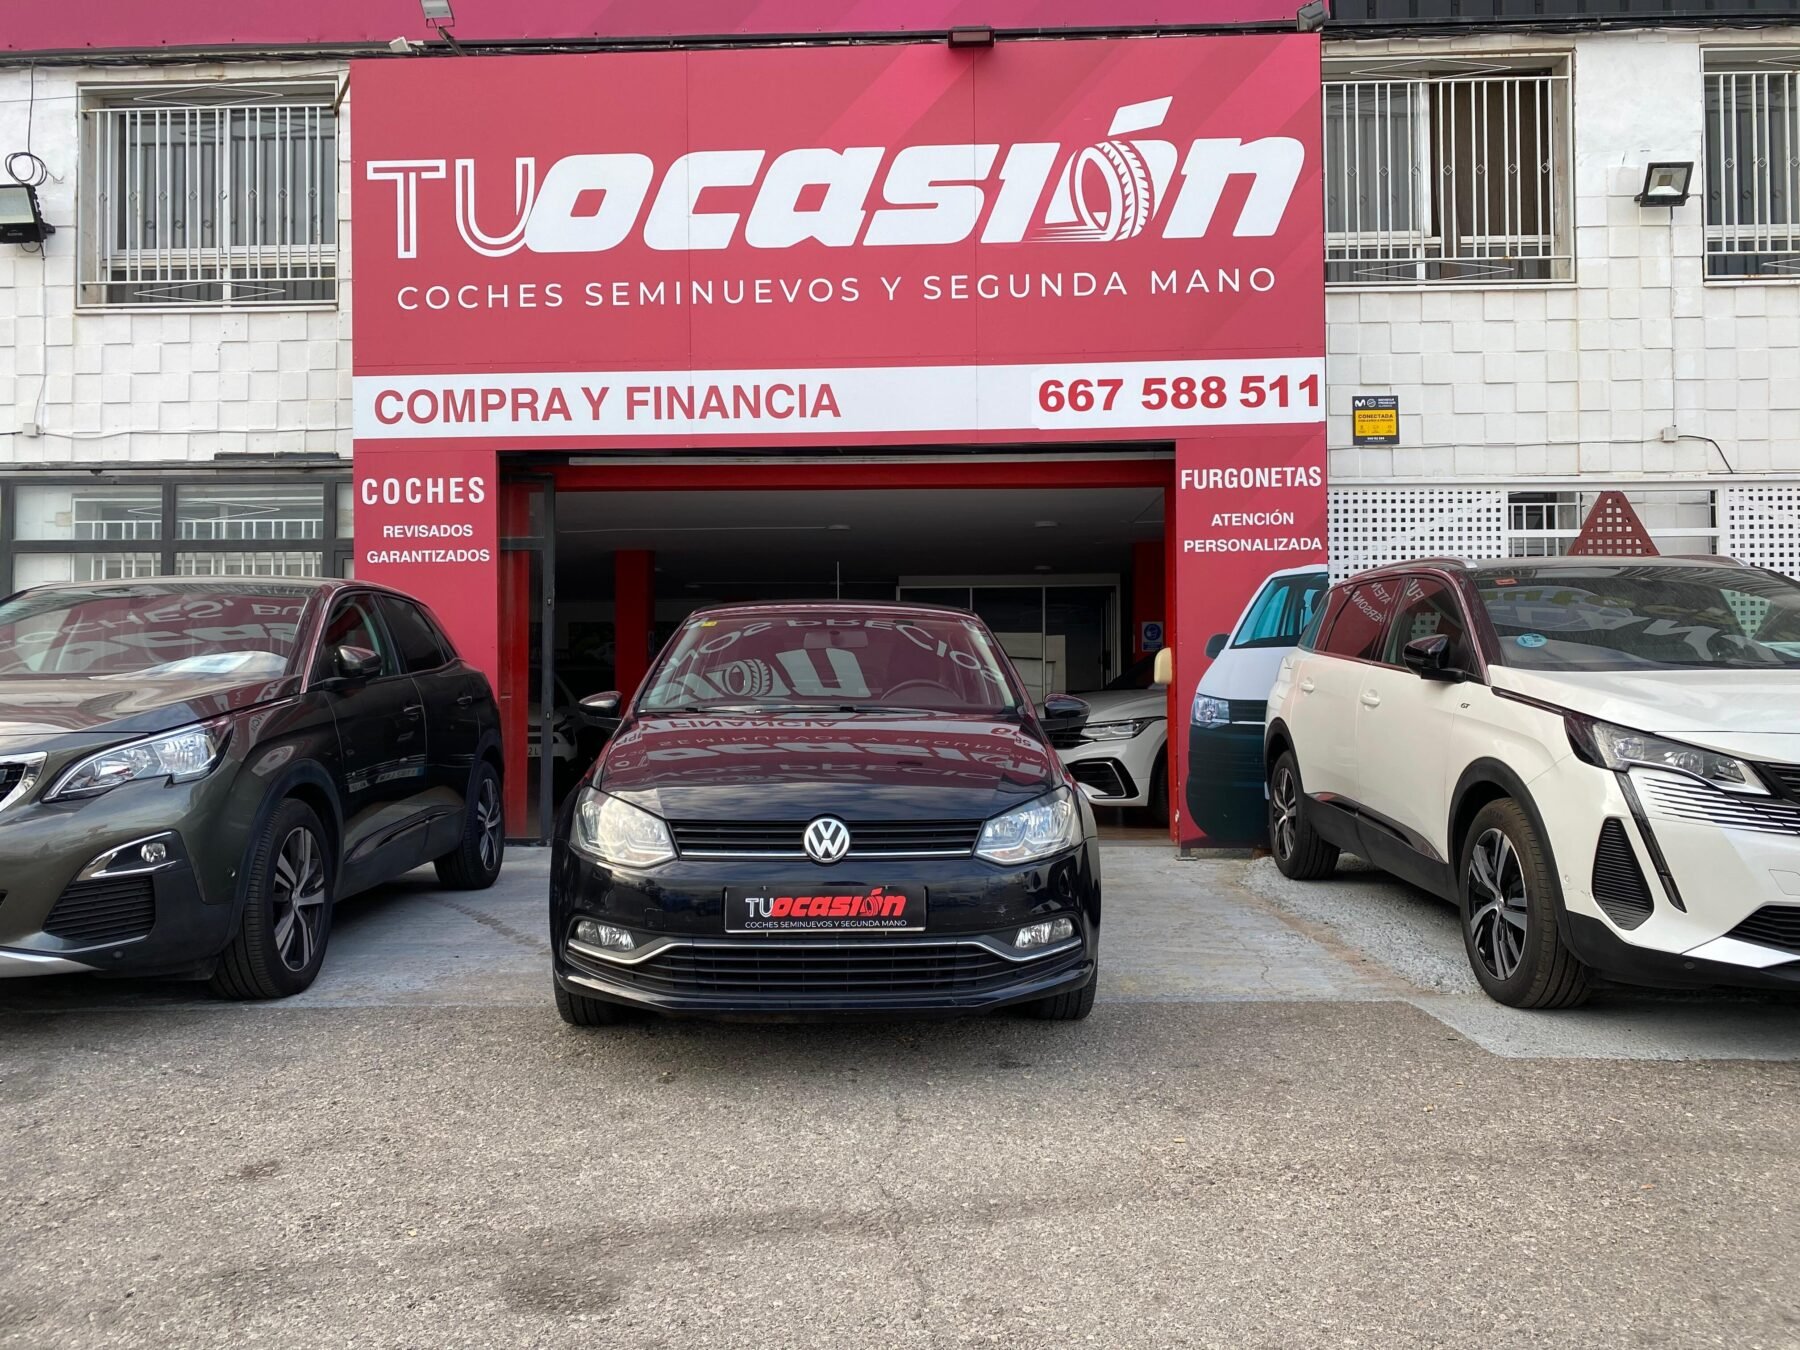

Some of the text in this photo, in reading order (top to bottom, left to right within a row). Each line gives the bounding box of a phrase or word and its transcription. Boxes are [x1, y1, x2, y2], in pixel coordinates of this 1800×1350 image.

[397, 267, 1275, 310] COCHES SEMINUEVOS Y SEGUNDA MANO
[374, 374, 1319, 424] COMPRA Y FINANCIA 667 588 511
[1181, 466, 1322, 490] FURGONETAS
[361, 476, 485, 505] COCHES
[1211, 508, 1294, 527] ATENCIÓN
[383, 524, 473, 538] REVISADOS
[1183, 537, 1323, 553] PERSONALIZADA
[366, 549, 490, 563] GARANTIZADOS
[745, 919, 907, 929] COCHES SEMINUEVOS Y SEGUNDA MANO
